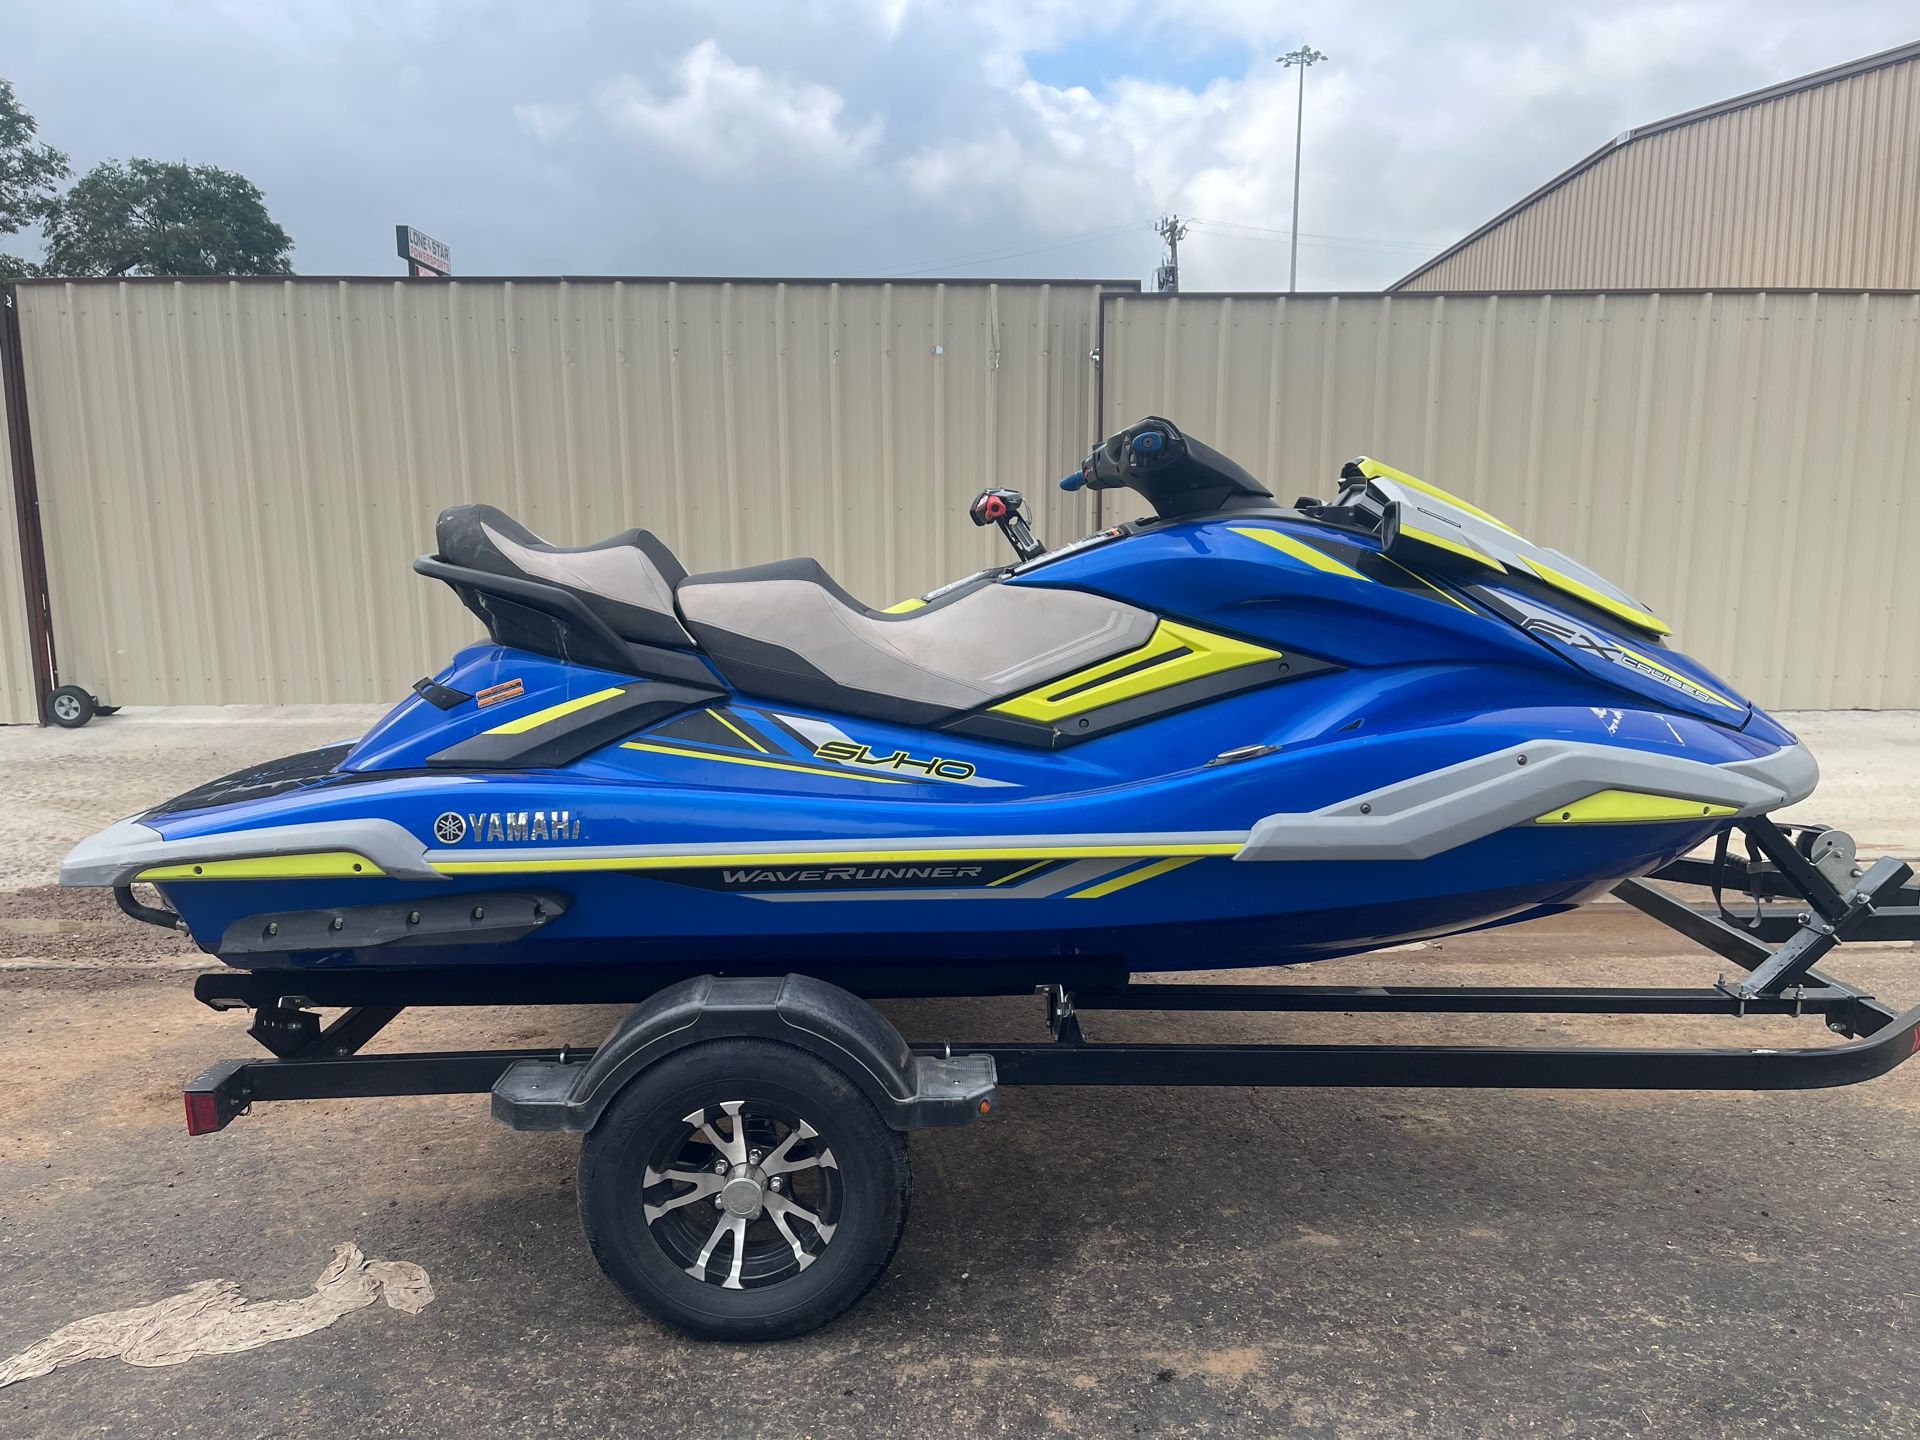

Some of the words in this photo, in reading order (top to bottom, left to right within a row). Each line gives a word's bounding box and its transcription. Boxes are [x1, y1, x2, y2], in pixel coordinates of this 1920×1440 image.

[410, 229, 428, 251] LONE
[432, 241, 449, 262] STAR
[1520, 617, 1623, 662] FX
[1621, 655, 1711, 702] CRUISER
[813, 740, 976, 780] SVHO
